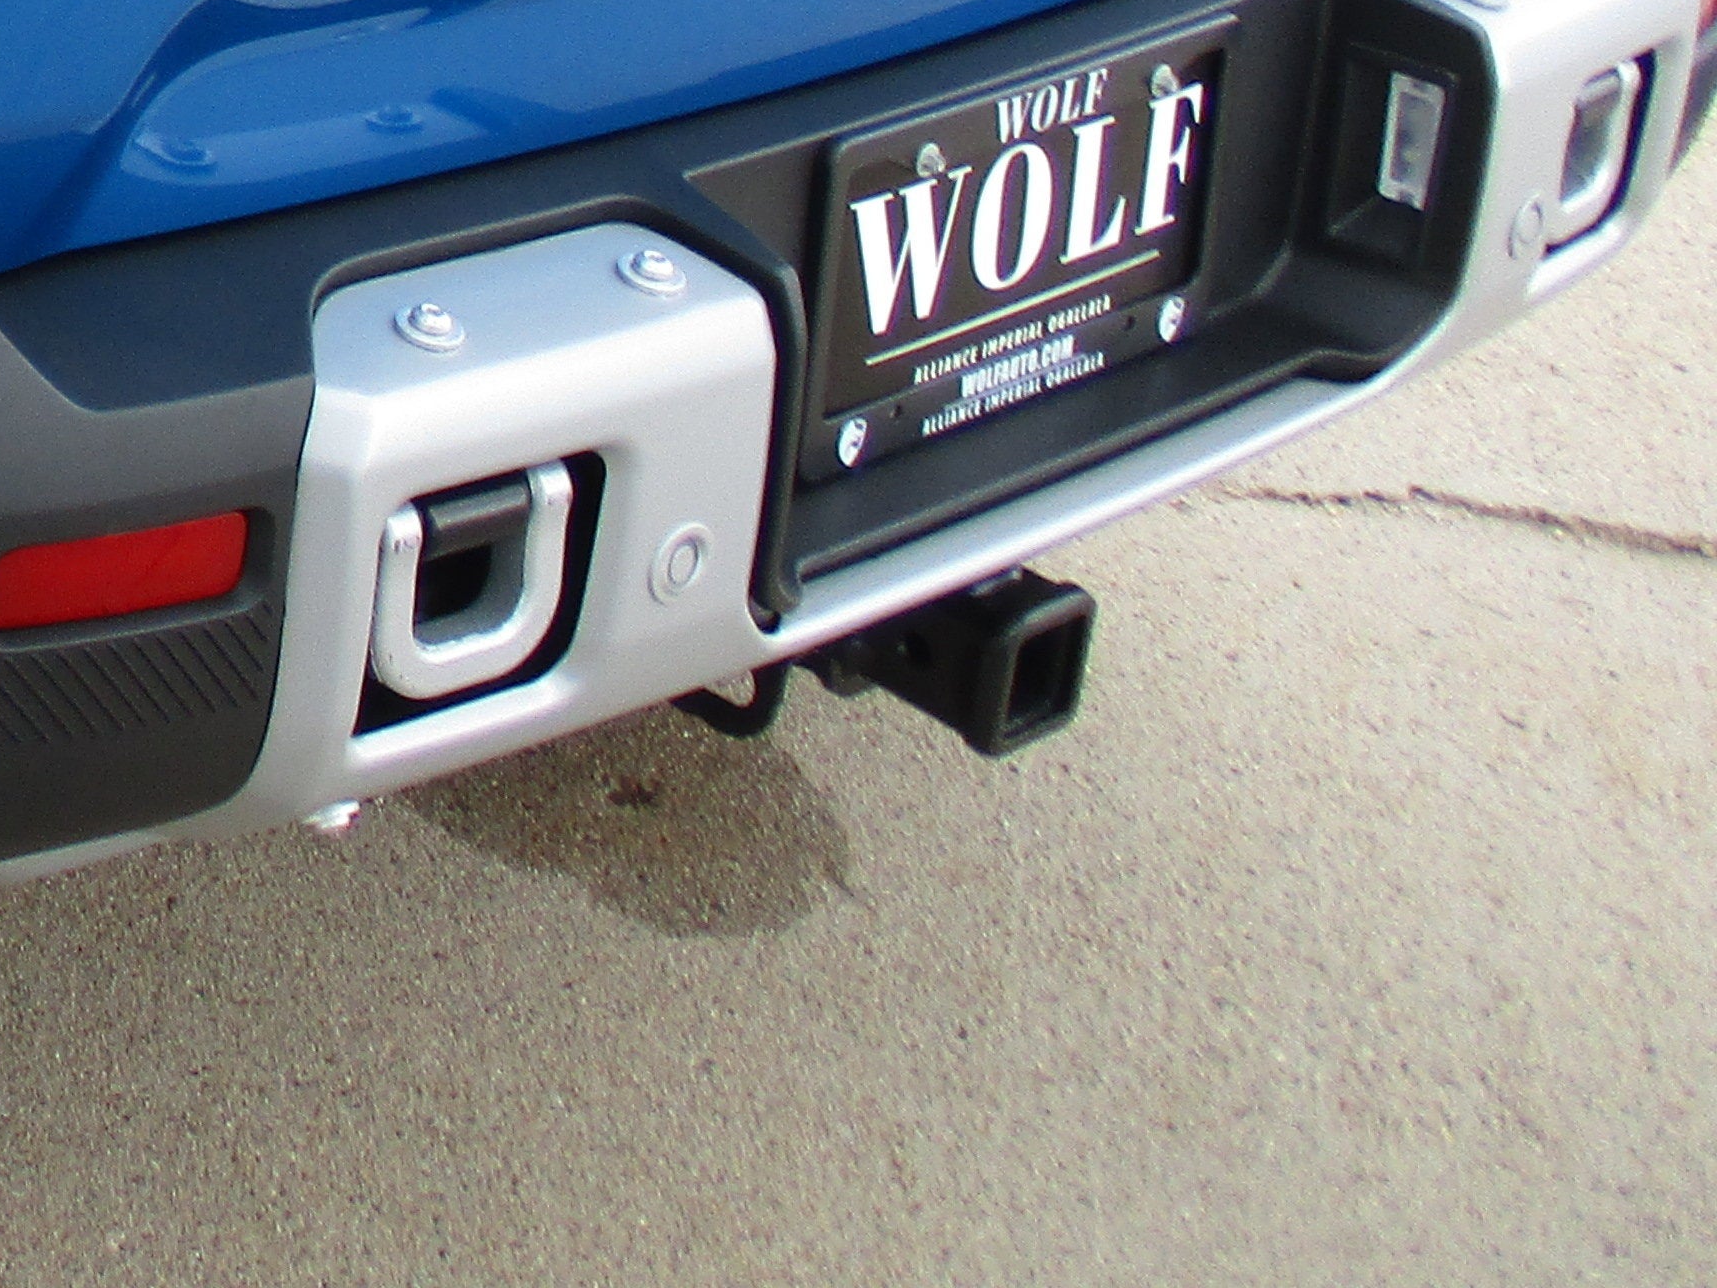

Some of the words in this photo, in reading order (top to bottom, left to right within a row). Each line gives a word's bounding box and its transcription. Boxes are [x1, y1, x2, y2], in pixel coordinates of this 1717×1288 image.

[997, 69, 1109, 142] WOLF
[850, 82, 1203, 335] WOLF
[914, 345, 979, 385] ALLIANCE
[982, 321, 1043, 359] IMPERIAL
[961, 334, 1074, 398] WOLFAUTO.COM
[922, 400, 981, 437] ALLIANCE
